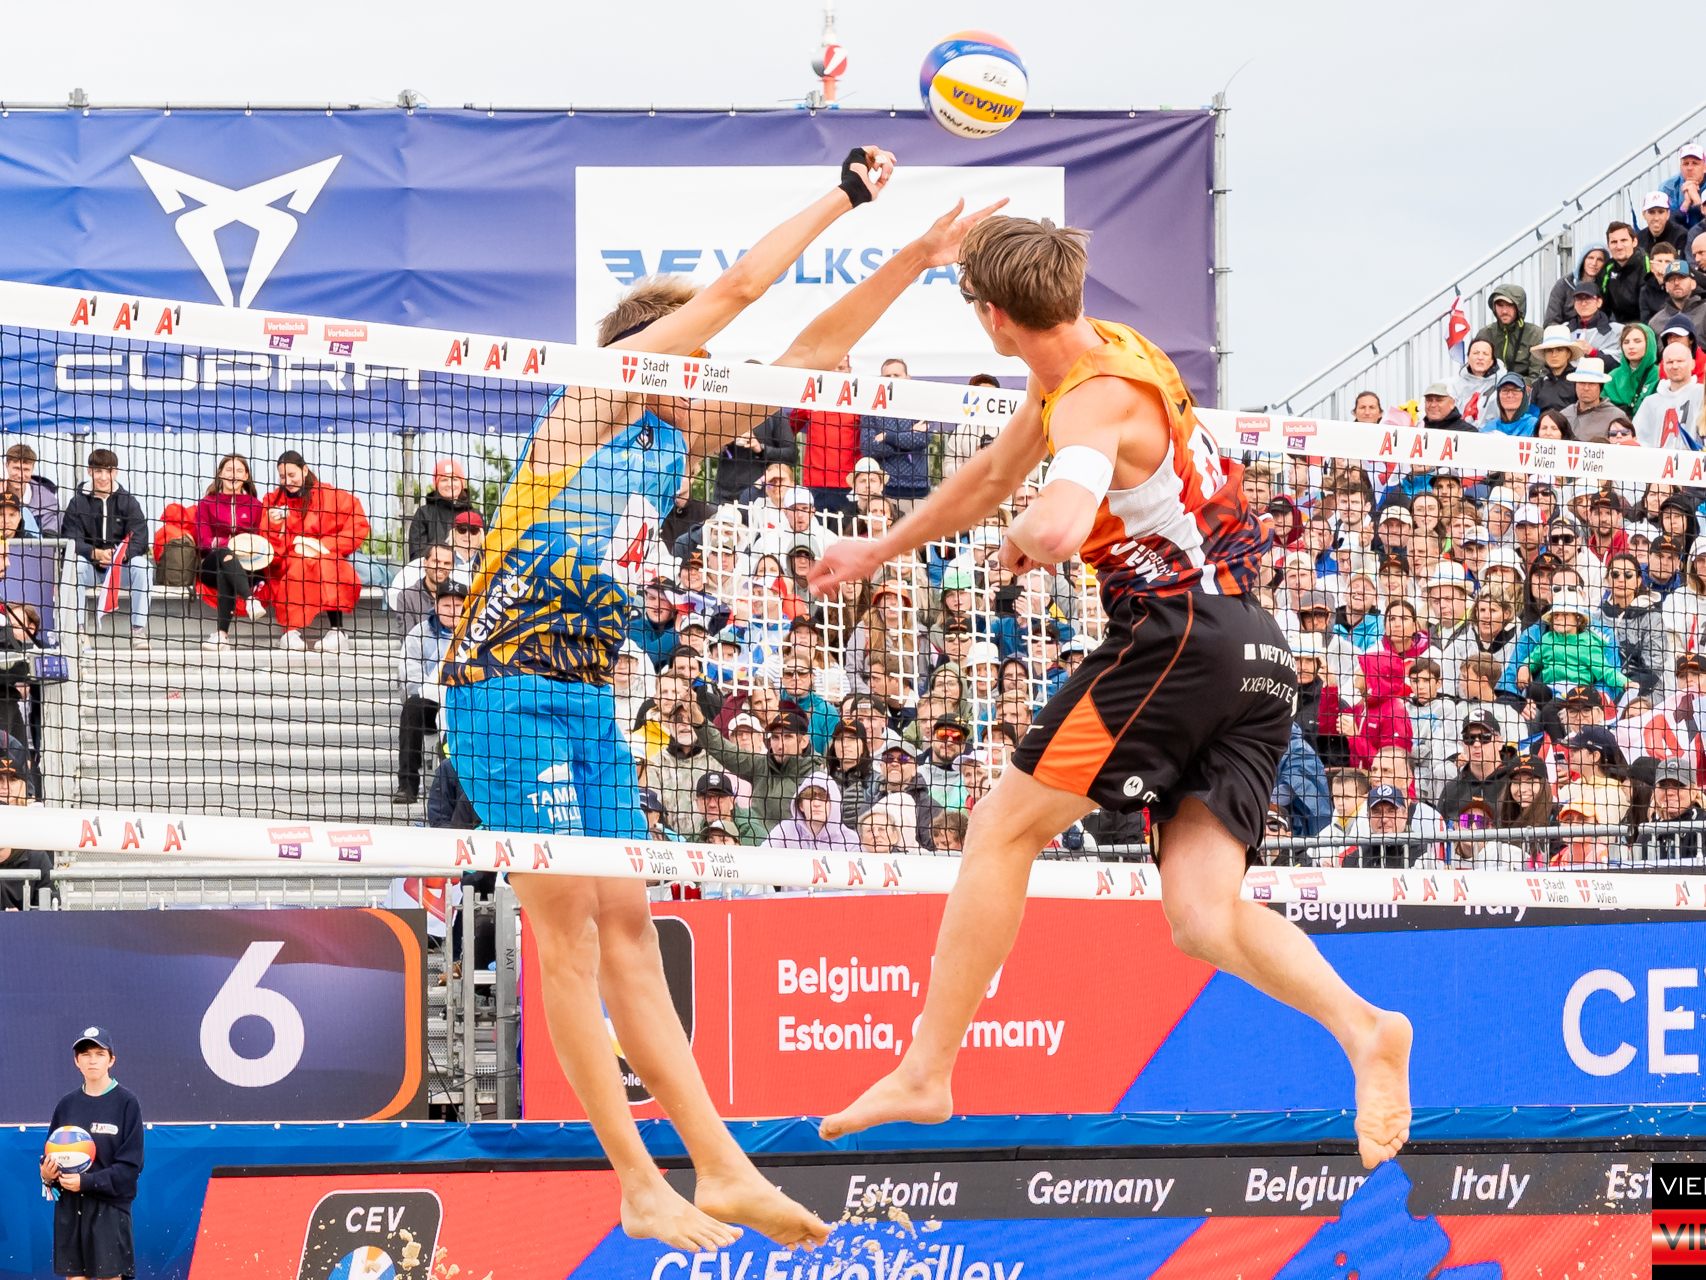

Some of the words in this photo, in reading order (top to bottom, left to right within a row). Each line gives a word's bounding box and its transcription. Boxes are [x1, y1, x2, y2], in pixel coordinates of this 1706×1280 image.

[70, 296, 97, 326] A1
[113, 301, 139, 331] A1
[155, 306, 181, 335] A1
[445, 337, 469, 367] A1
[484, 342, 507, 371] A1
[522, 346, 546, 375] A1
[642, 357, 669, 373] Stadt
[703, 364, 730, 379] Stadt
[641, 372, 667, 388] Wien
[702, 378, 728, 394] Wien
[800, 374, 823, 404] A1
[836, 378, 858, 407] A1
[872, 382, 894, 411] A1
[987, 398, 1017, 415] CEV
[1379, 430, 1398, 456] A1
[1410, 432, 1429, 459] A1
[1440, 435, 1459, 461] A1
[1535, 442, 1556, 456] Stadt
[1583, 447, 1605, 460] Stadt
[1534, 456, 1555, 469] Wien
[1582, 461, 1603, 473] Wien
[1662, 453, 1679, 479] A1
[79, 816, 103, 848] A1
[121, 818, 145, 850] A1
[163, 820, 187, 852] A1
[455, 835, 476, 866] A1
[494, 838, 515, 868] A1
[532, 840, 553, 870] A1
[646, 848, 674, 861] Stadt
[707, 851, 735, 864] Stadt
[650, 862, 678, 876] Wien
[712, 866, 739, 879] Wien
[812, 856, 832, 885] A1
[848, 858, 867, 886] A1
[882, 860, 902, 888] A1
[1096, 867, 1114, 896] A1
[1130, 868, 1147, 897] A1
[1546, 891, 1569, 903] Wien
[1596, 892, 1618, 904] Wien
[777, 956, 920, 1003] Belgium,
[200, 941, 305, 1087] 6
[1562, 967, 1706, 1076] CE
[778, 1013, 903, 1056] Estonia,
[911, 1013, 1065, 1056] rmany
[845, 1171, 958, 1208] Estonia
[1027, 1170, 1175, 1211] Germany
[1452, 1164, 1530, 1209] Italy
[345, 1206, 406, 1232] CEV
